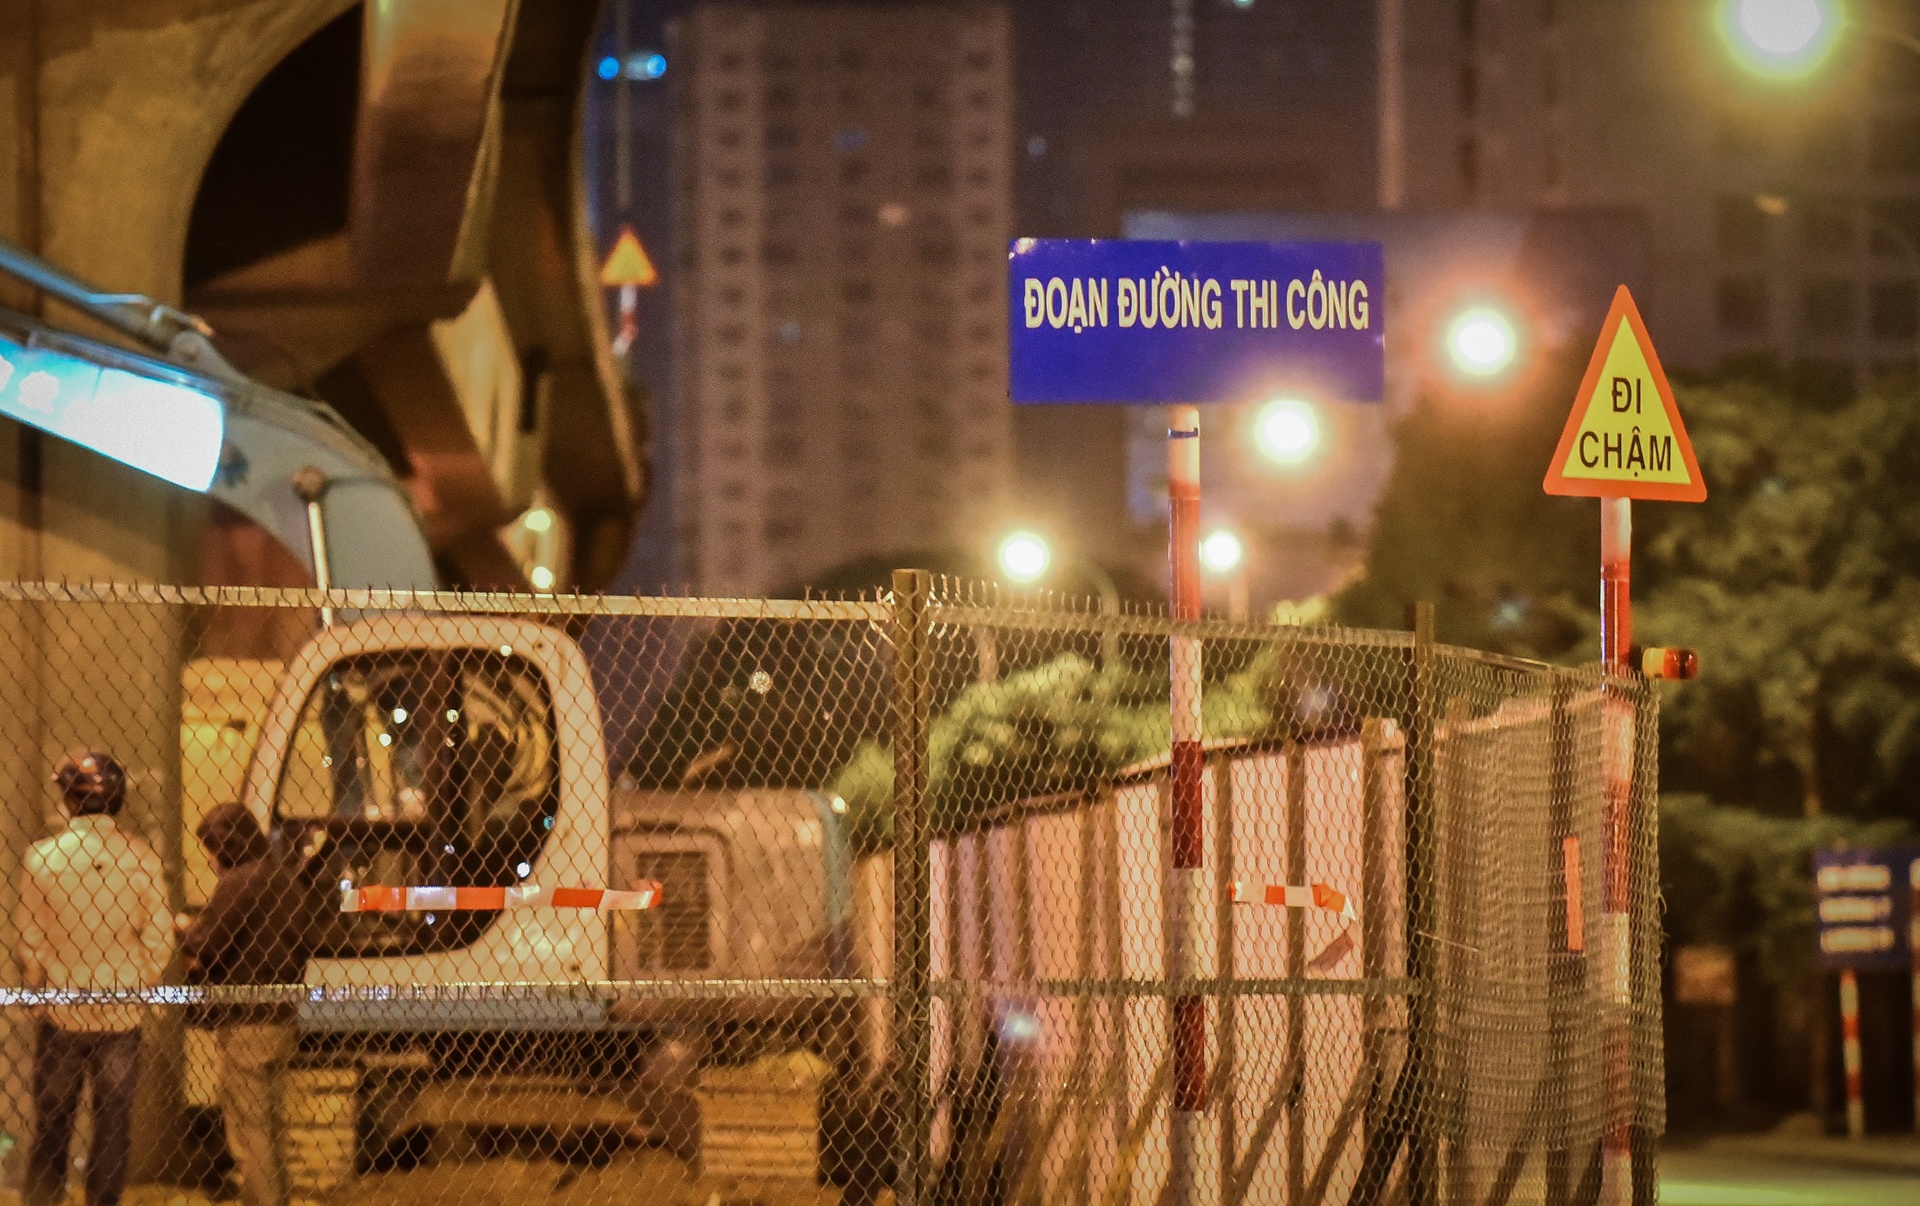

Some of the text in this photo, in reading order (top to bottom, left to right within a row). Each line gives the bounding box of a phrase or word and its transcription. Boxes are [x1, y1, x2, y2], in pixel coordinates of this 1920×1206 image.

[1023, 265, 1370, 334] ĐOẠN ĐƯỜNG THI CÔNG
[1611, 376, 1642, 415] ĐI
[1579, 425, 1672, 477] CHẬM
